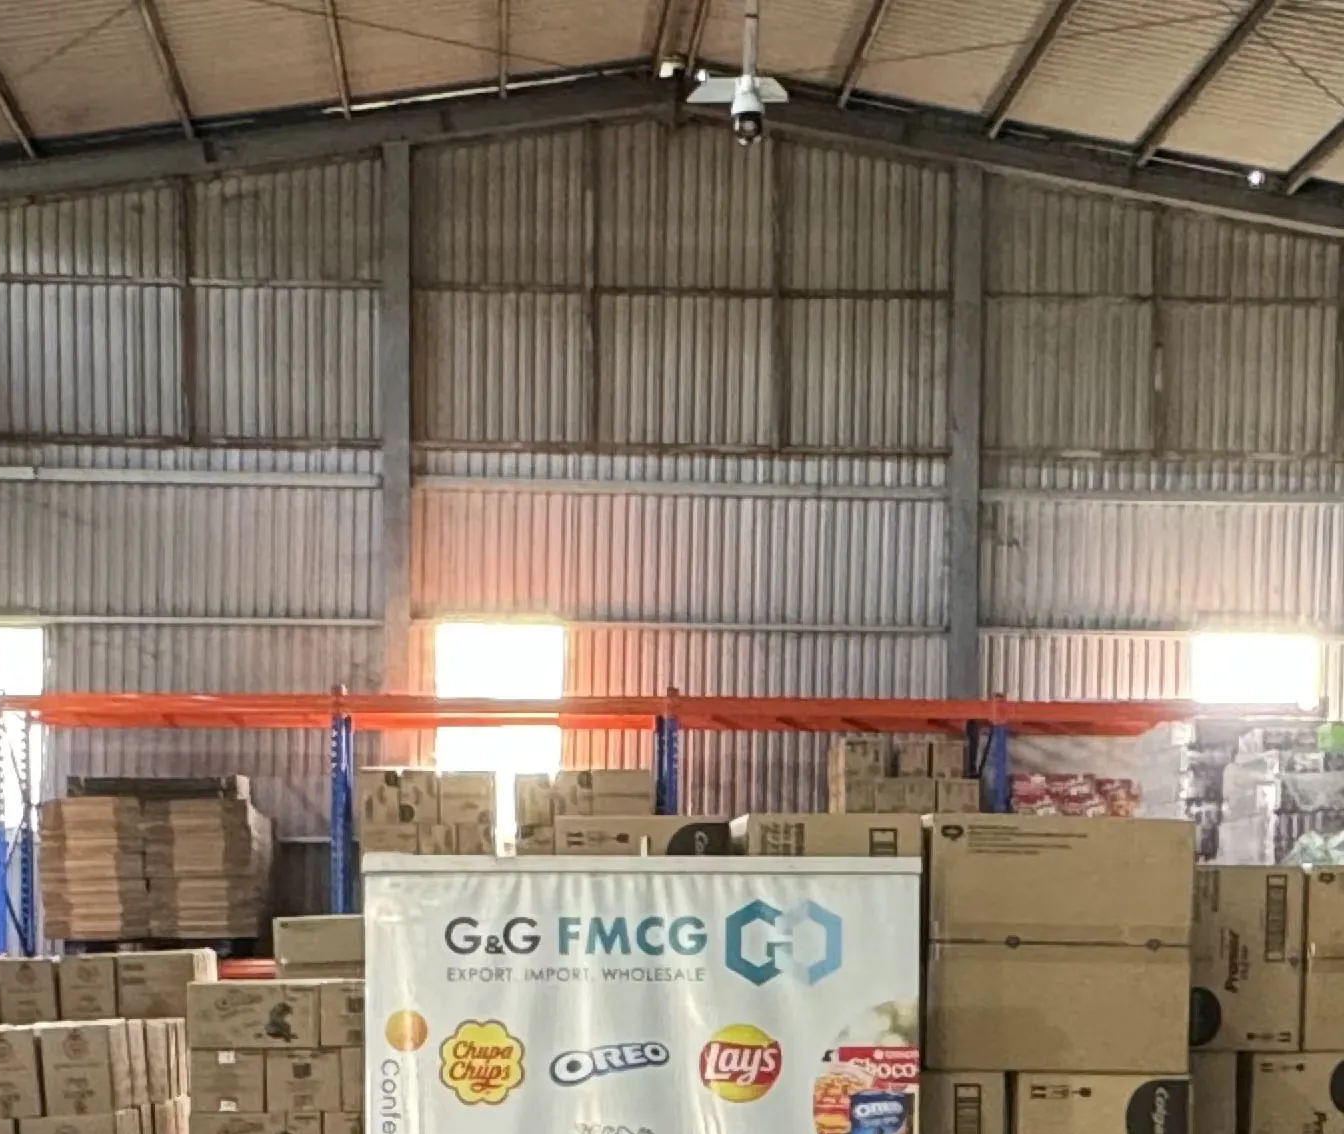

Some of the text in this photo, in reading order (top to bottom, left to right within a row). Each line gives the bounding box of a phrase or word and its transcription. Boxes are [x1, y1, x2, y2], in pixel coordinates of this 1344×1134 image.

[444, 916, 708, 955] G&G FMCG
[601, 967, 707, 983] WHOLESALE
[451, 1040, 514, 1064] Chupa
[552, 1043, 668, 1084] OREO
[448, 1061, 513, 1092] Chups
